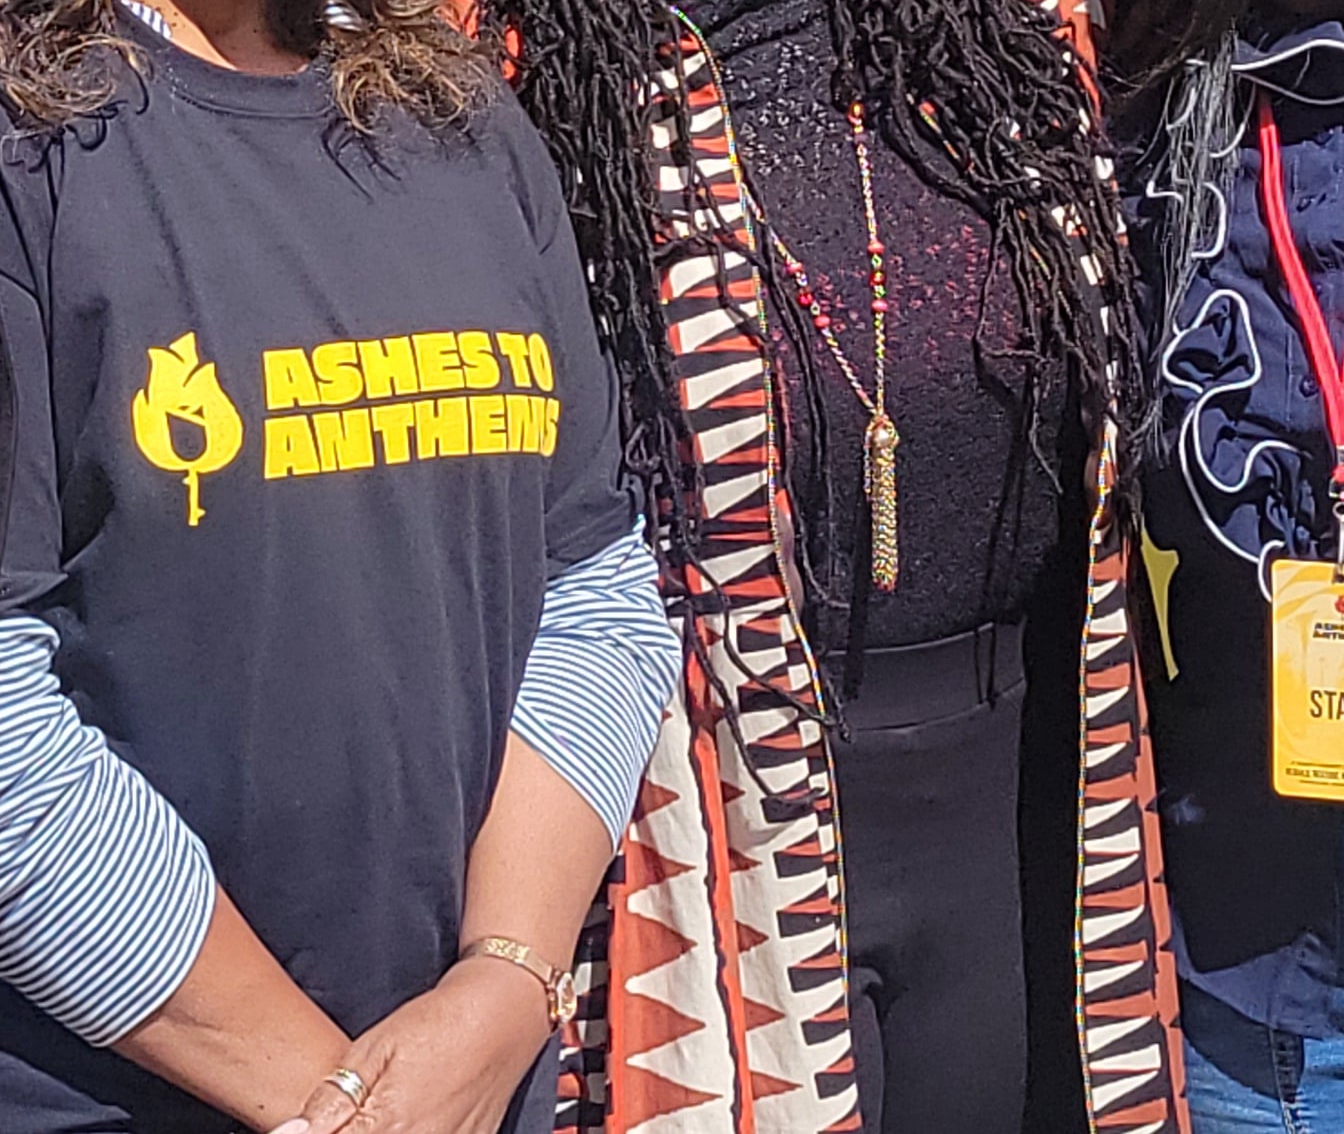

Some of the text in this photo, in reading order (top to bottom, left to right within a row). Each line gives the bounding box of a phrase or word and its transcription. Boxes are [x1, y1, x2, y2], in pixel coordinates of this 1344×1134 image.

[263, 331, 555, 410] ASHES TO
[264, 394, 560, 480] ANTHEMS
